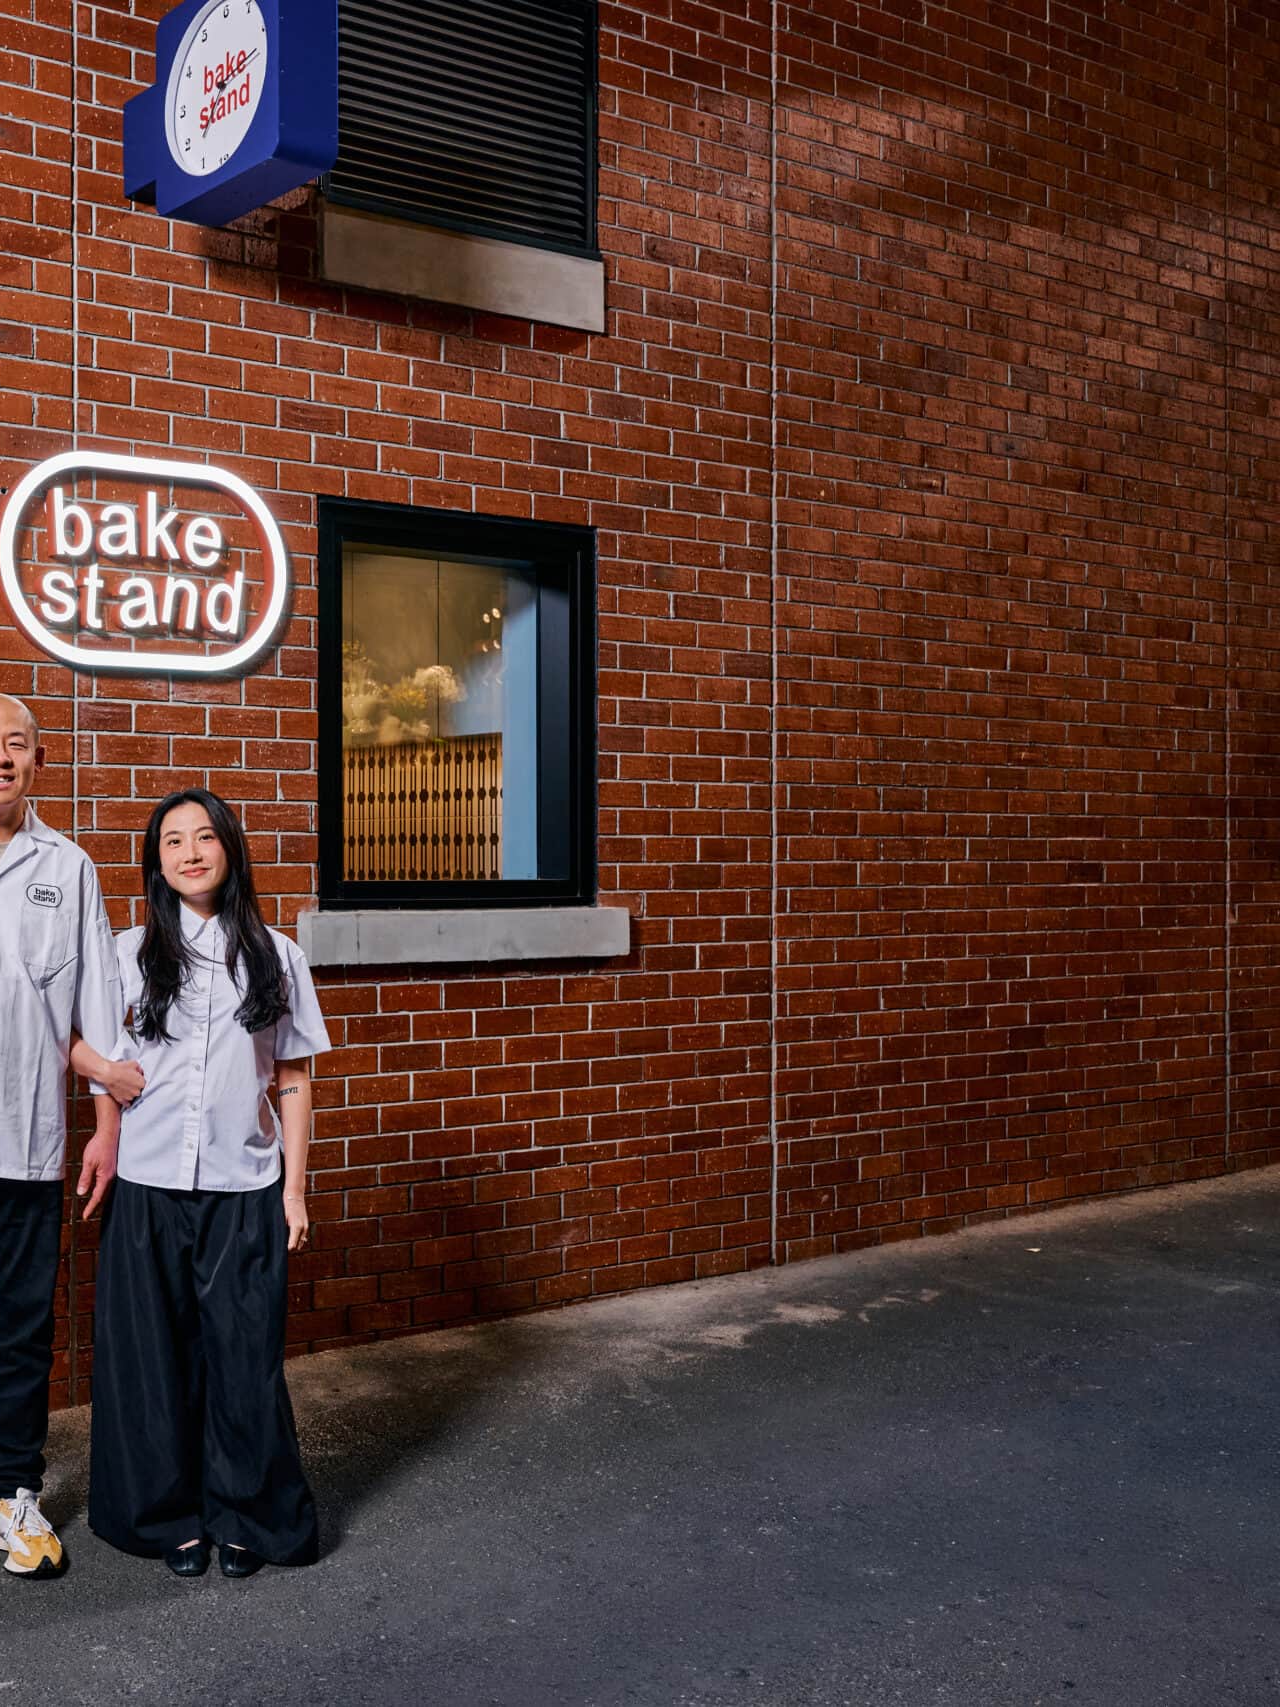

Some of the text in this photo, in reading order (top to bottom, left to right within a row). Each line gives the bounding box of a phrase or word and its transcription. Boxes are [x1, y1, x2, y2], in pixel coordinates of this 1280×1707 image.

[223, 5, 229, 18] 6
[201, 29, 208, 42] 5
[186, 66, 193, 79] 4
[203, 50, 247, 95] bake
[199, 74, 250, 129] stand
[180, 105, 186, 118] 3
[185, 138, 191, 151] 2
[52, 487, 223, 567] bake
[40, 563, 244, 635] stand
[34, 895, 56, 903] stand
[35, 888, 56, 897] bake
